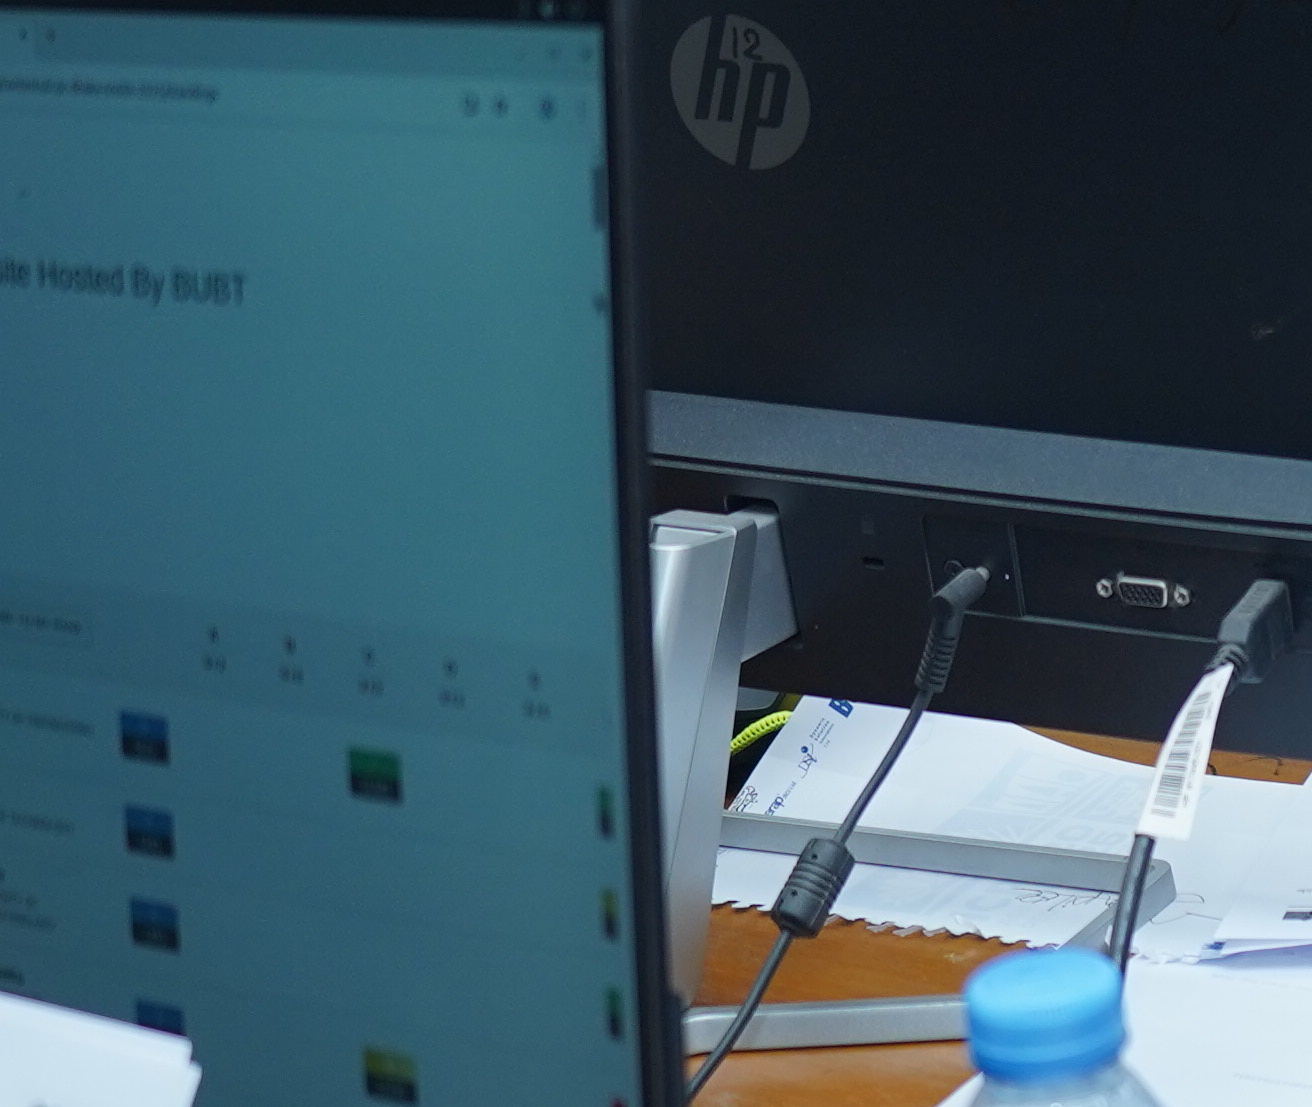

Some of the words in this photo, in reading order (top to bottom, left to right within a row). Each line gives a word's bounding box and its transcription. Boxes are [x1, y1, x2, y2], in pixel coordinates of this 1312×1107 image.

[730, 26, 762, 61] 12
[695, 15, 791, 170] hp
[37, 261, 124, 298] Hosted
[131, 264, 164, 307] By
[171, 271, 247, 307] BUBT
[764, 795, 786, 817] erap
